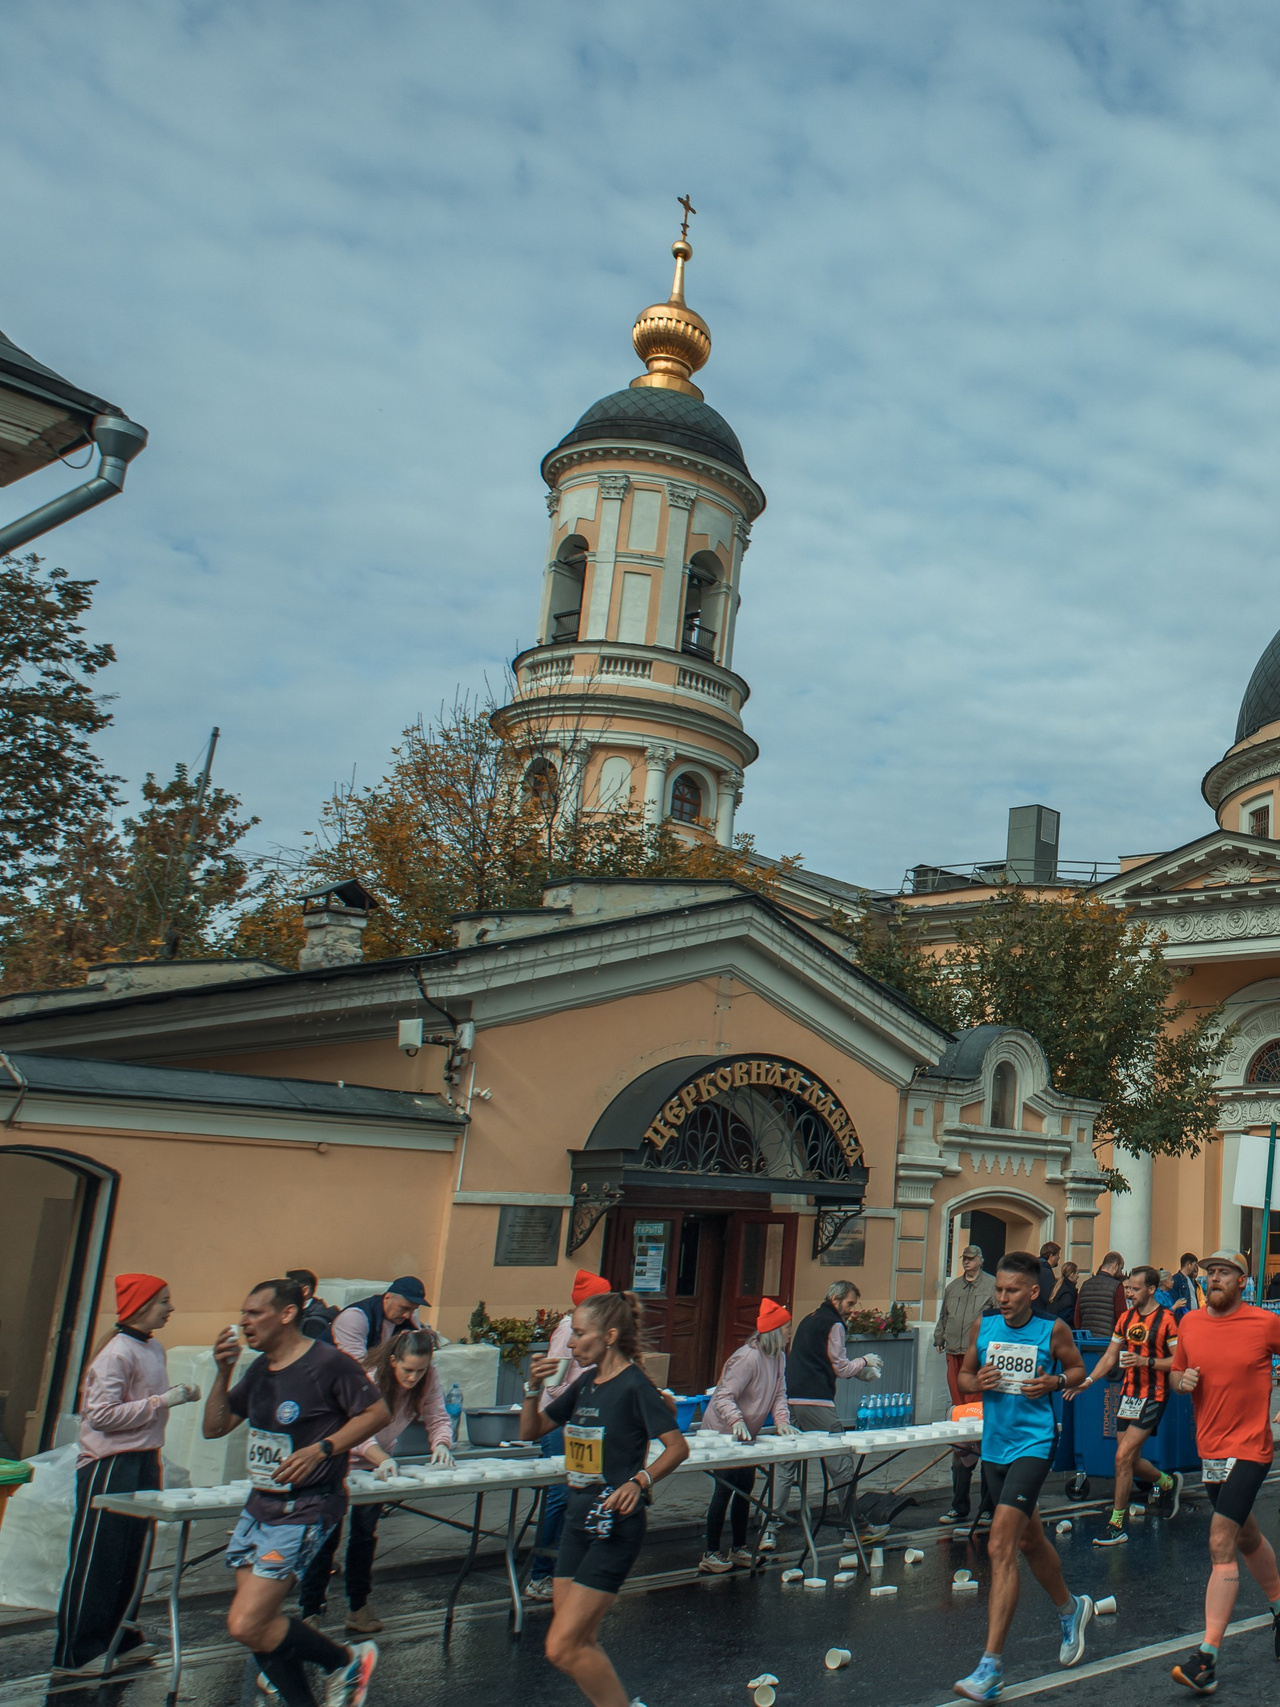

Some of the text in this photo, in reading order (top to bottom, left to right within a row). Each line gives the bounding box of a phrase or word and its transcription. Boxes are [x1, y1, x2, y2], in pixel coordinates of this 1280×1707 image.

[643, 1060, 865, 1167] ЦЕРКОВНАЯ ЛАВКА
[989, 1354, 1034, 1373] 18888
[249, 1443, 283, 1465] 6904
[569, 1441, 593, 1462] 1771
